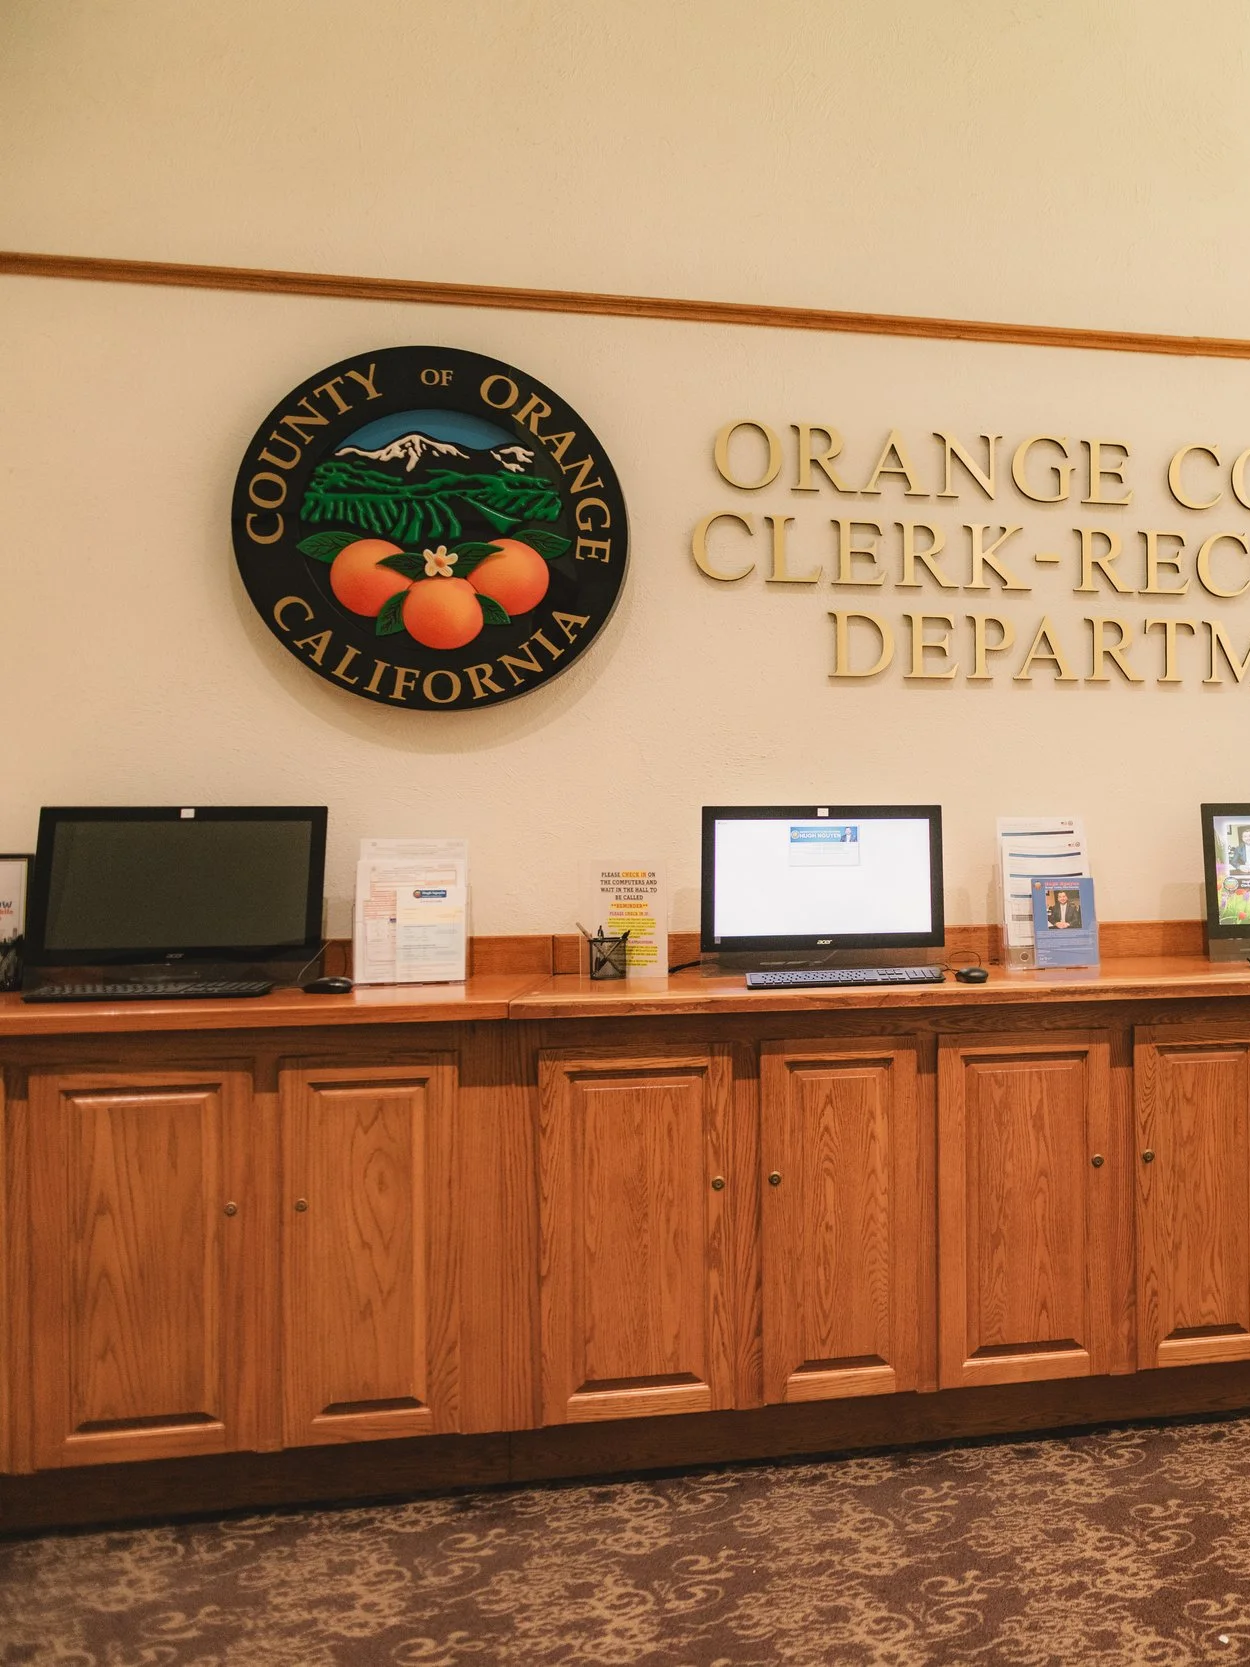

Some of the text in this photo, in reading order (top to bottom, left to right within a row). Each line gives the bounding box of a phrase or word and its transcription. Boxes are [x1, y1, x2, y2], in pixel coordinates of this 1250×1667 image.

[246, 363, 612, 564] COUNTY OF ORANGE
[714, 418, 1134, 506] ORANGE
[272, 595, 590, 704] CALIFORNIA
